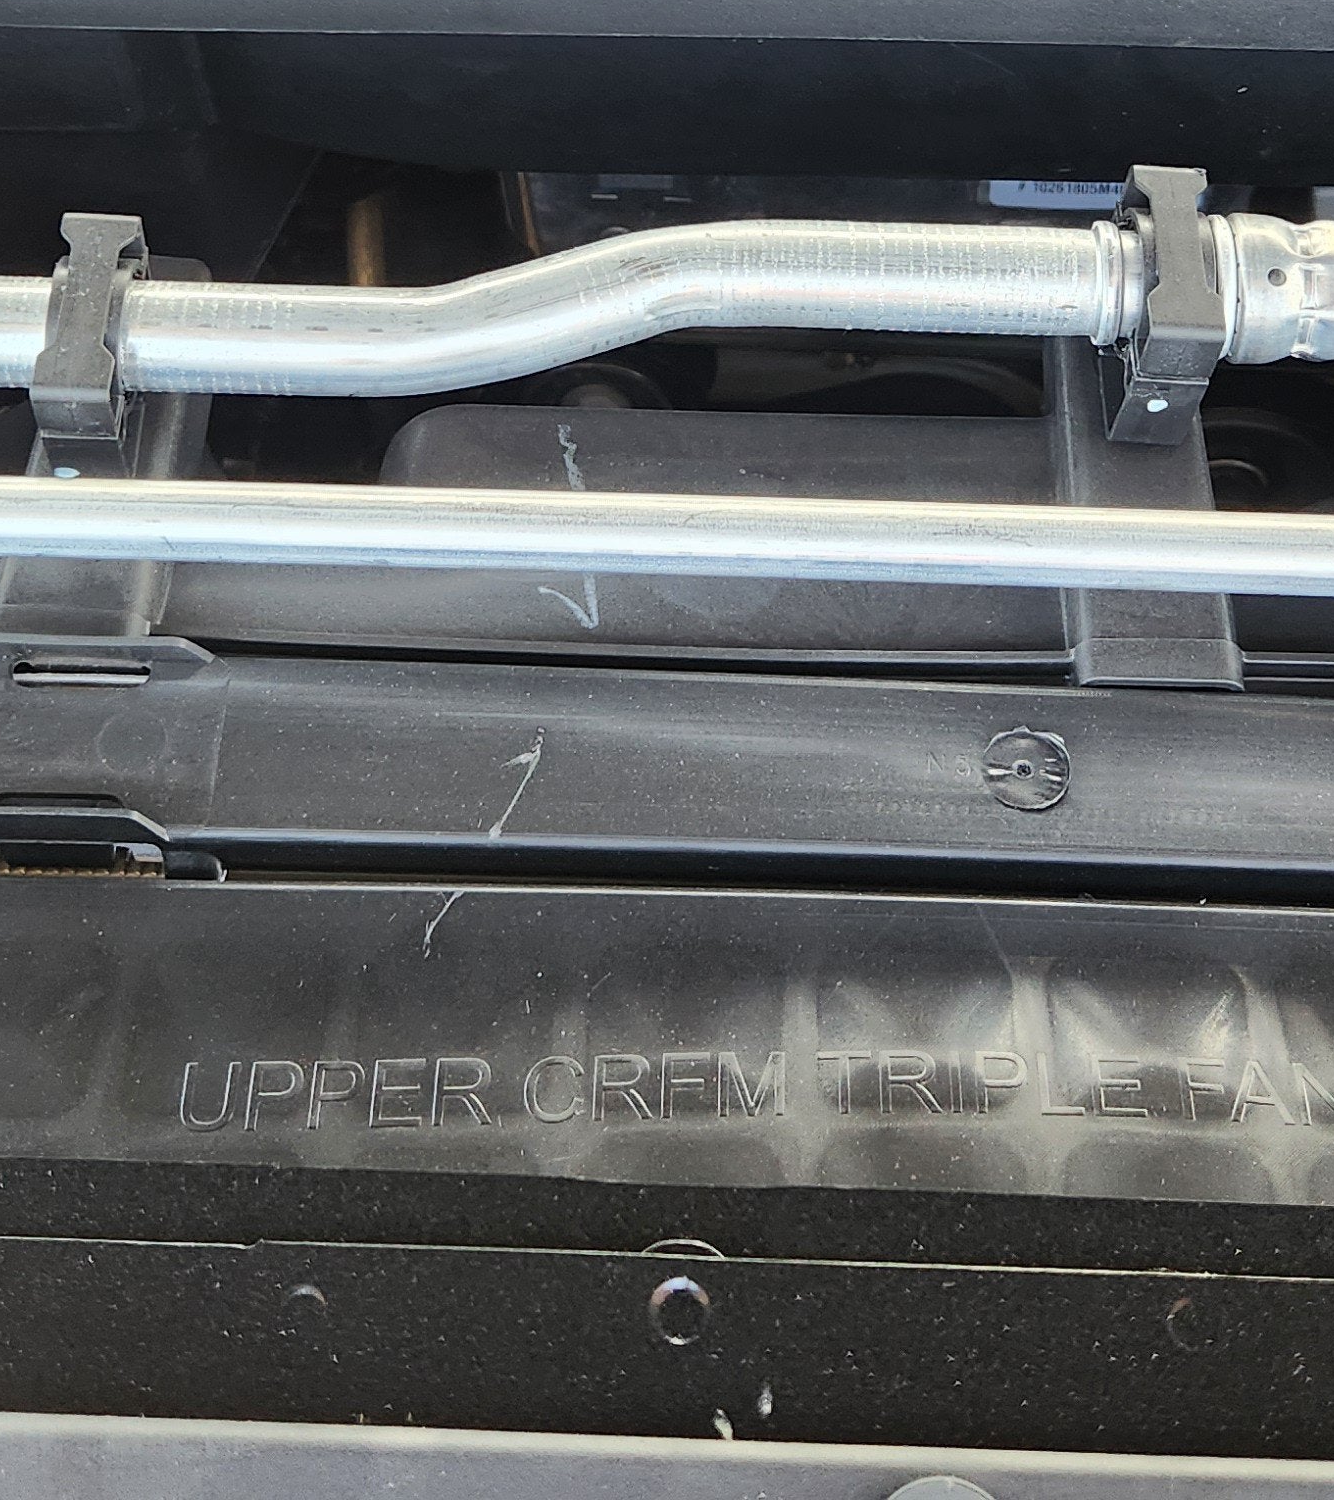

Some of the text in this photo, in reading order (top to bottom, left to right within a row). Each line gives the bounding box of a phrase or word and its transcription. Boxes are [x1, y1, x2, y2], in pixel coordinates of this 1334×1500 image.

[179, 1056, 493, 1133] UPPER
[523, 1051, 788, 1124] CRFM
[816, 1049, 1148, 1119] TRIPLE
